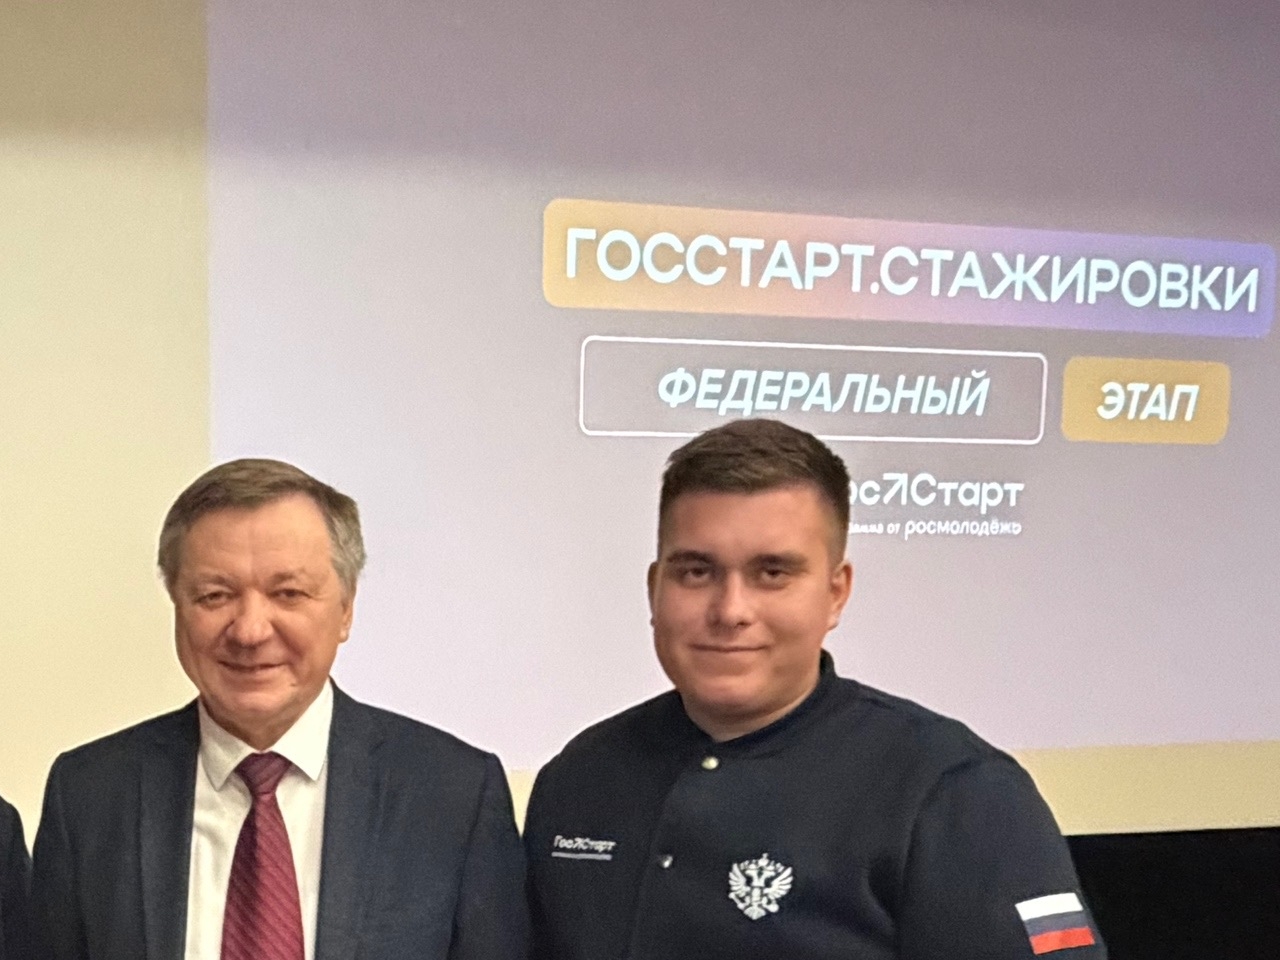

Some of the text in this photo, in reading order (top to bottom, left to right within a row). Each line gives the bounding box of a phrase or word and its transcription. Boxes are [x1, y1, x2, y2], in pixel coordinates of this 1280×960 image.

[565, 228, 1260, 312] ГОССТАРТ.СТАЖИРОВКИ
[658, 370, 1199, 422] ФЕДЕРАЛЬНЫЙ ЭТАП
